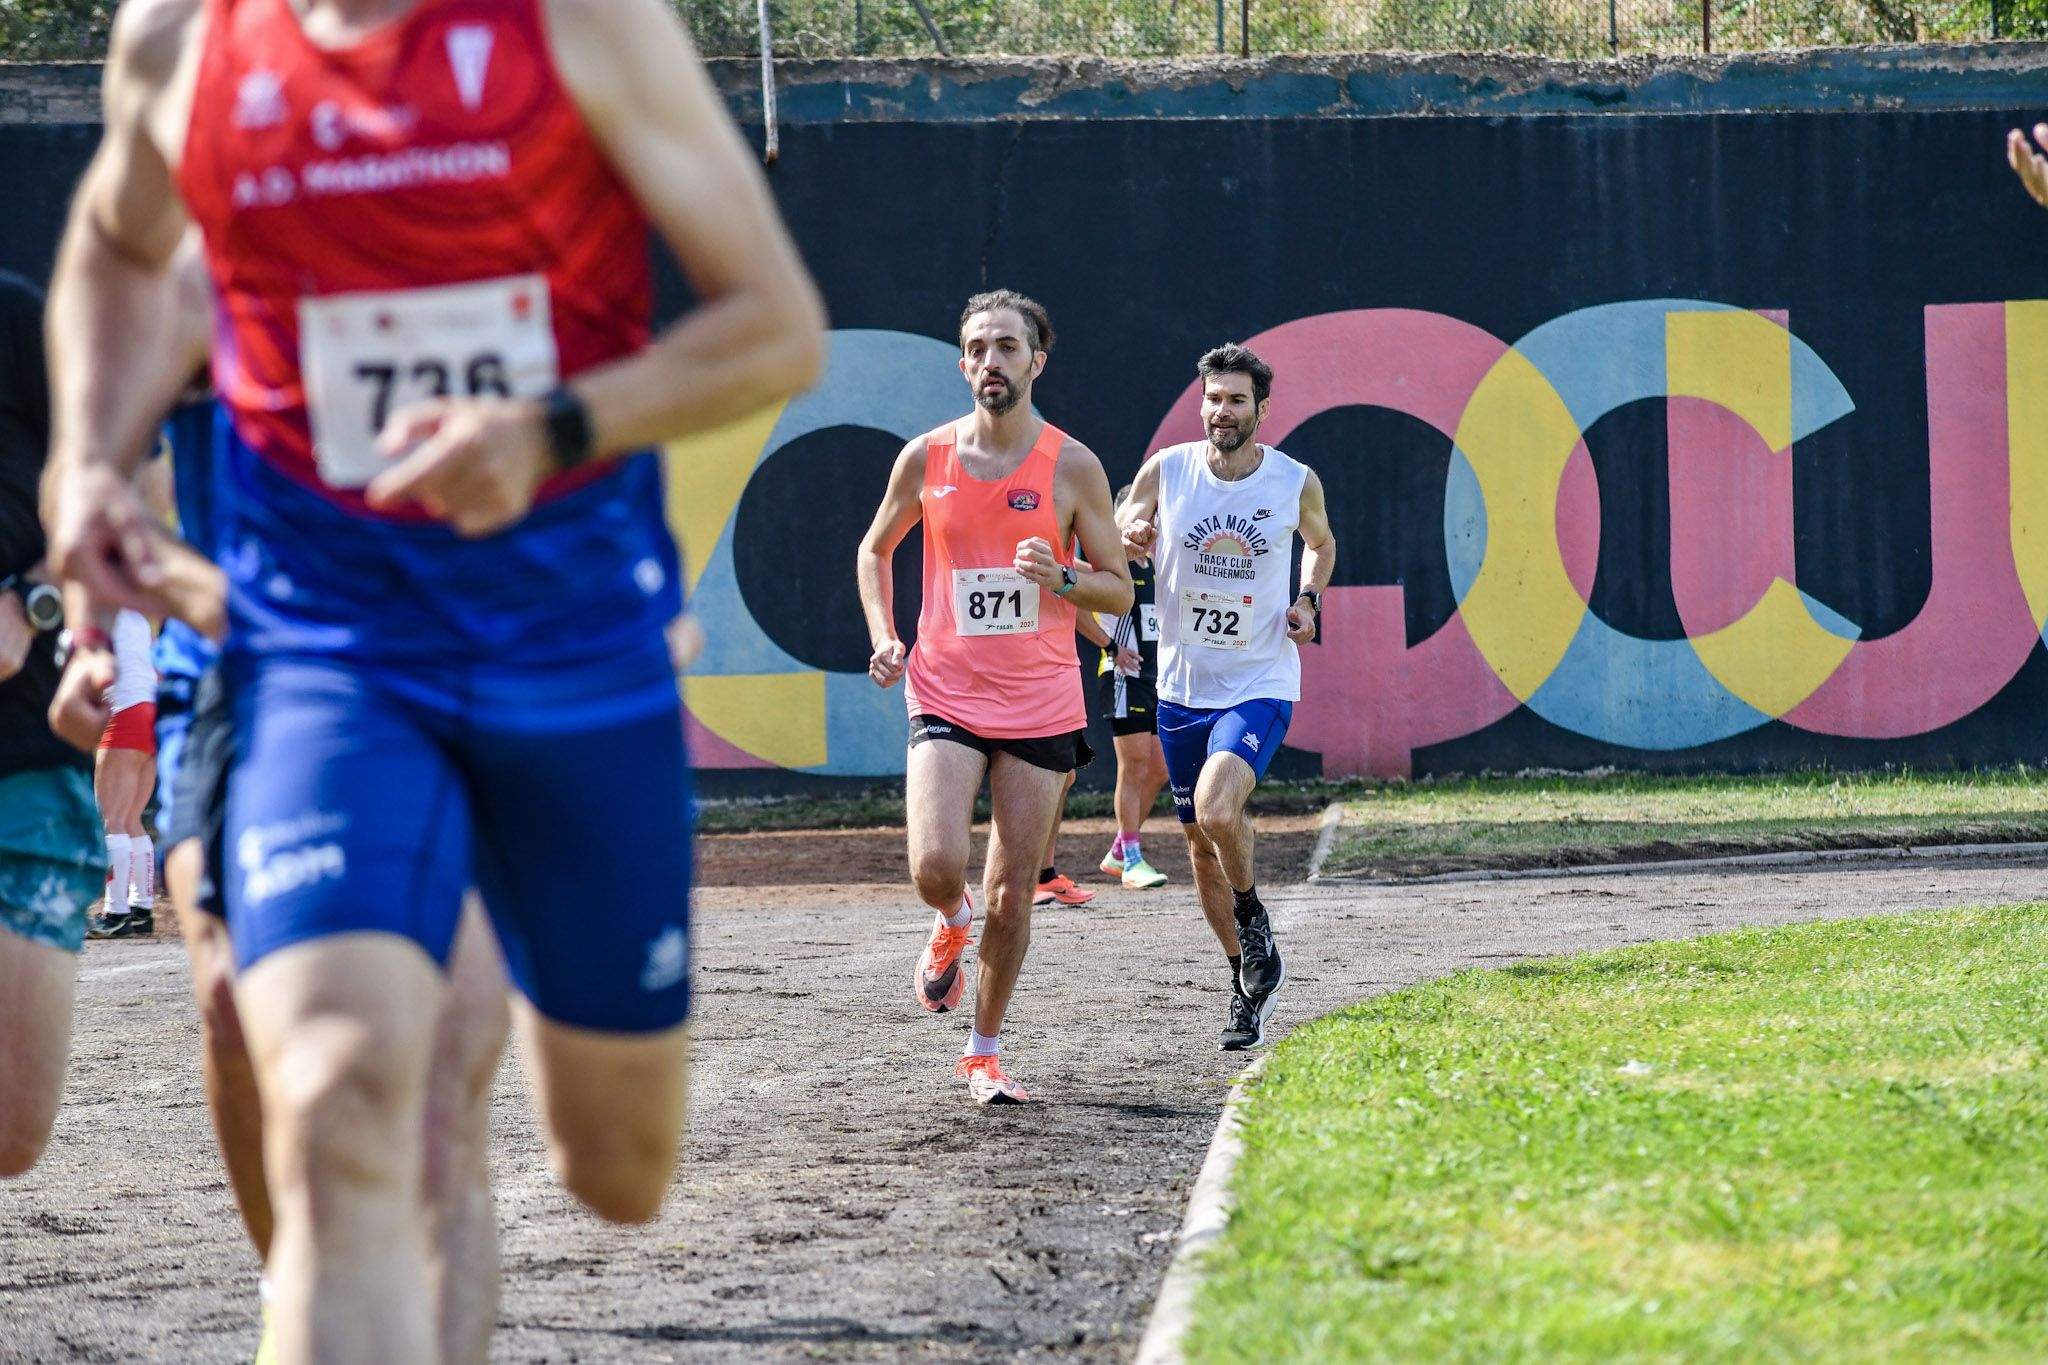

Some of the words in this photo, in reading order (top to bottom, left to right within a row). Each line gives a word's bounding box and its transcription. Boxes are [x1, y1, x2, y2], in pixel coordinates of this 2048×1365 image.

[301, 141, 512, 196] MARATHON
[1256, 508, 1272, 516] NIKE
[1184, 515, 1222, 551] SANTA
[1225, 514, 1269, 557] MONICA
[1194, 563, 1256, 581] VALLEHERMOSO
[1199, 553, 1228, 567] TRACK
[1230, 557, 1253, 569] CLUB
[969, 590, 1021, 619] 871
[1020, 620, 1035, 628] 2023
[1192, 607, 1240, 636] 732
